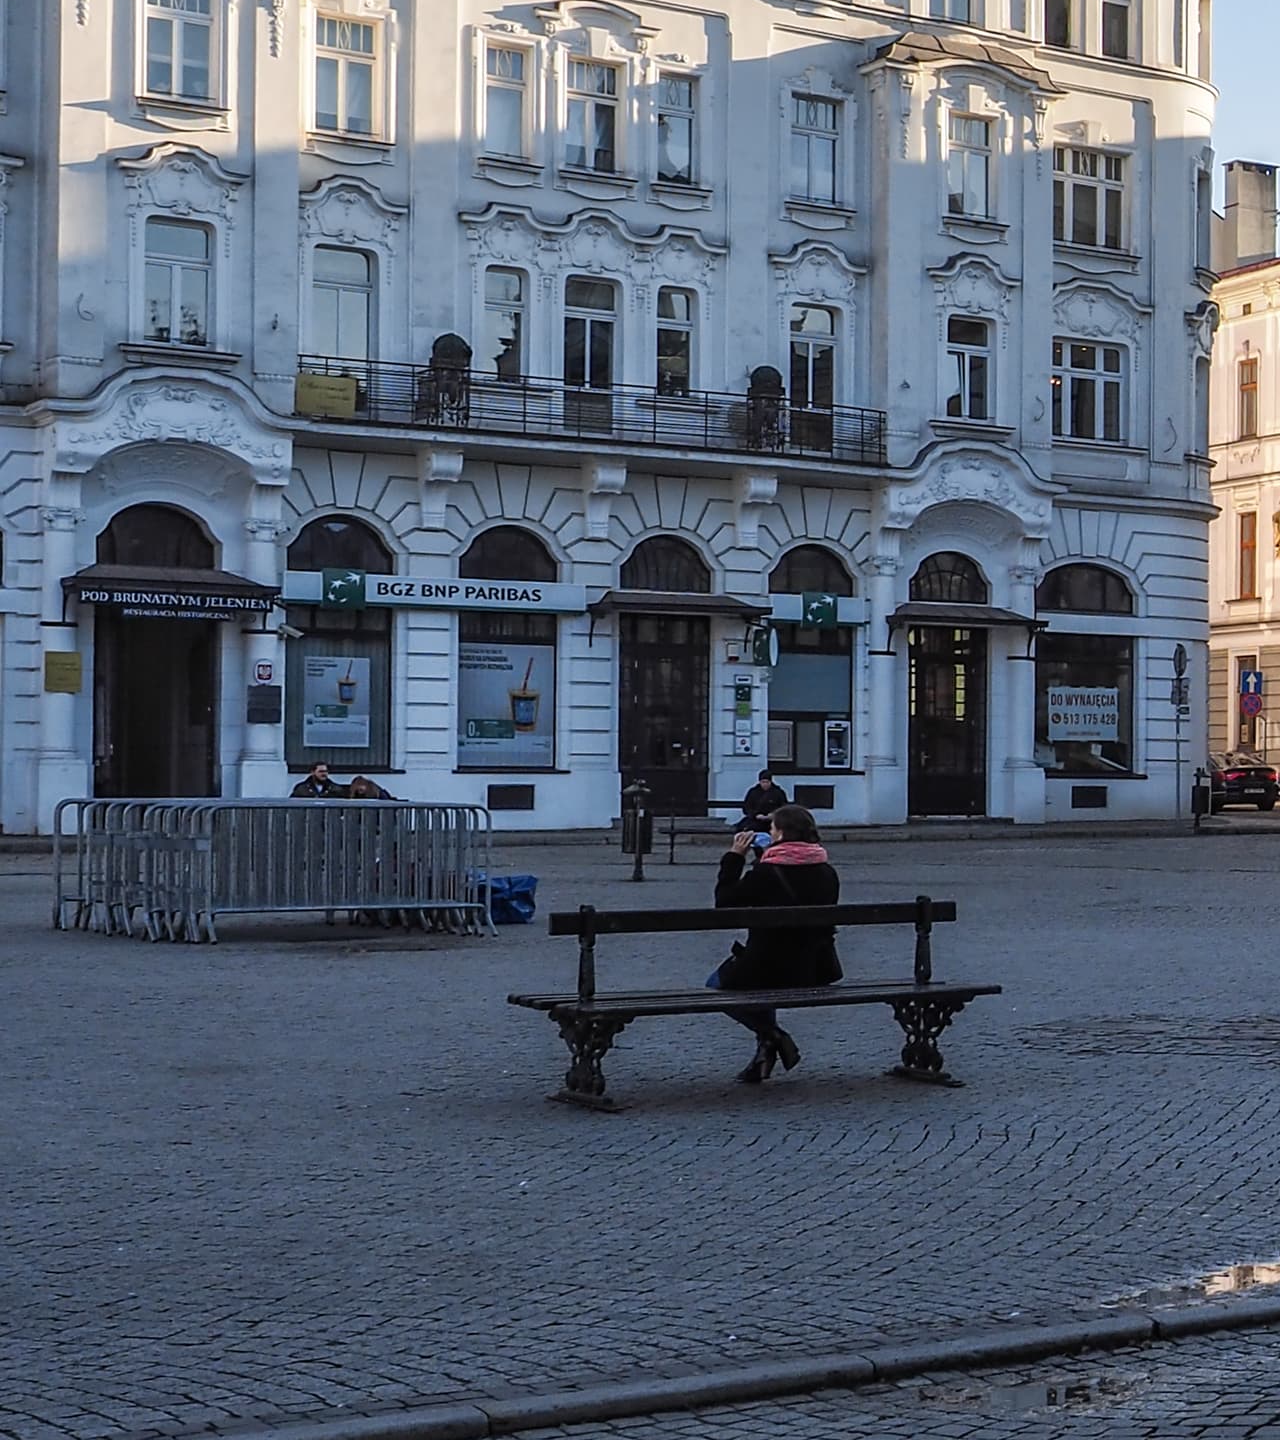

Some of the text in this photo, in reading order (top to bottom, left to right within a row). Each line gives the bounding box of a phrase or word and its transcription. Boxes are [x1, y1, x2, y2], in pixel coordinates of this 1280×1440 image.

[81, 590, 271, 610] POD BRUNATNYM JELENIEM
[421, 584, 460, 599] BNP
[464, 586, 542, 602] PARIBAS
[1051, 693, 1116, 708] DO WYNAJĘCIA
[1063, 713, 1080, 725] 513
[1083, 714, 1098, 725] 175
